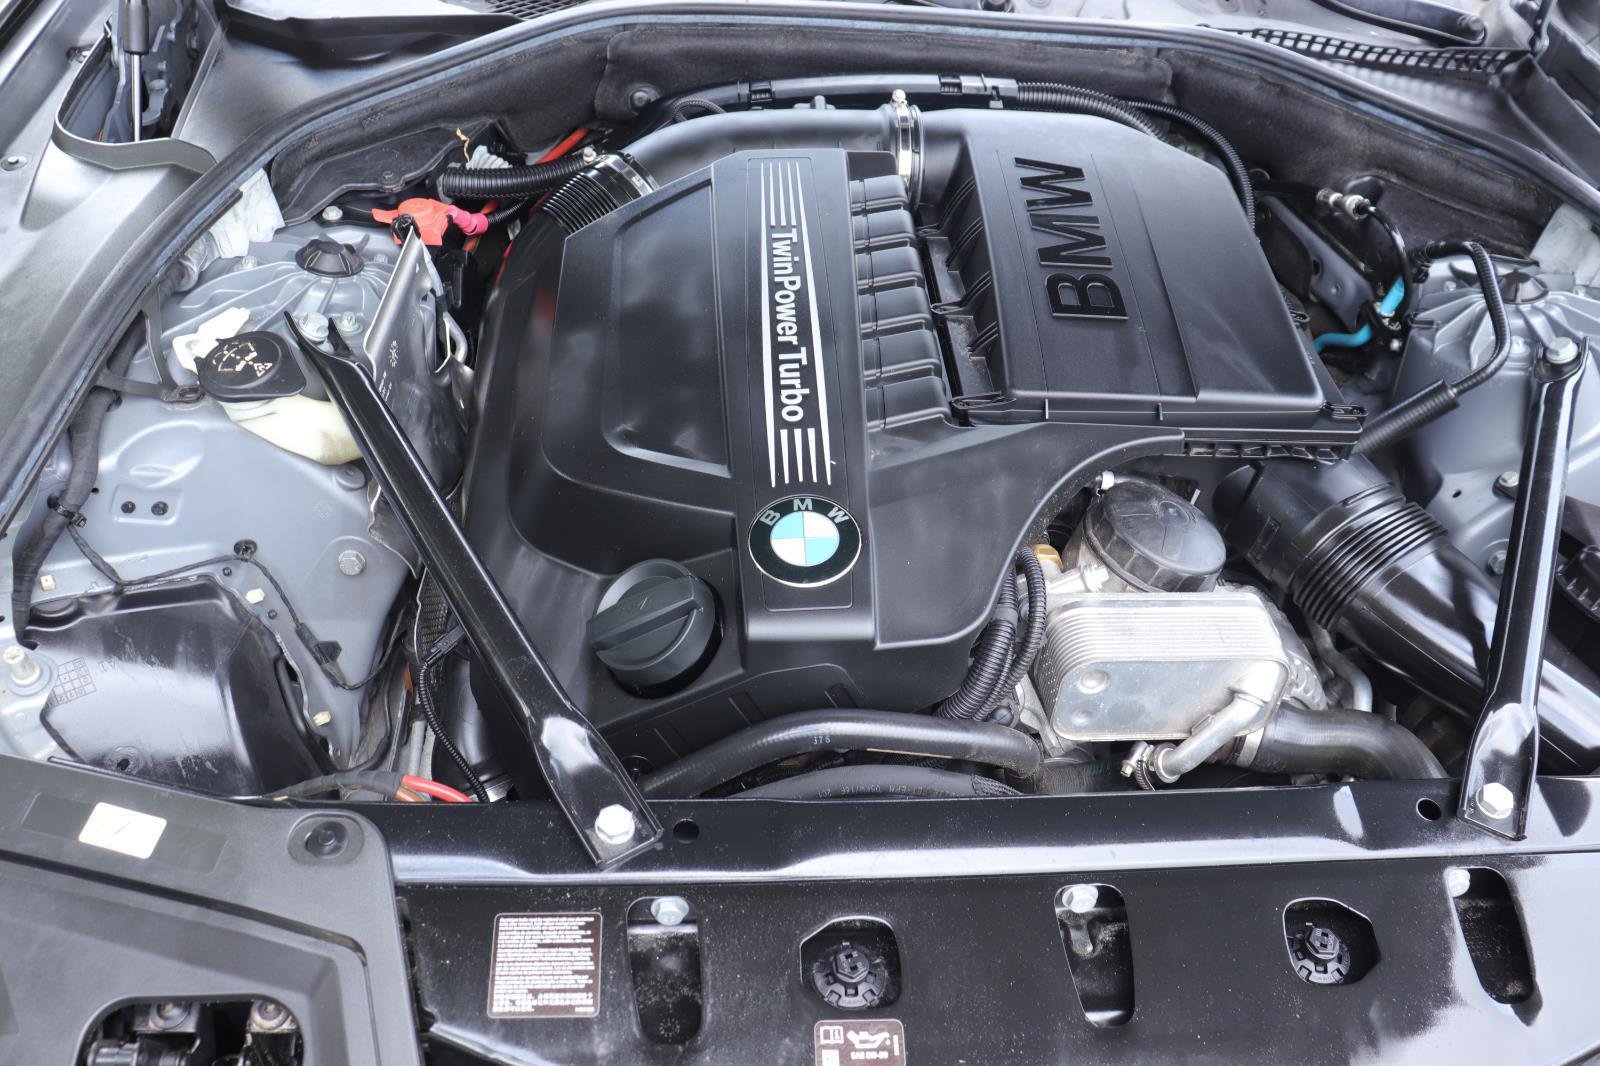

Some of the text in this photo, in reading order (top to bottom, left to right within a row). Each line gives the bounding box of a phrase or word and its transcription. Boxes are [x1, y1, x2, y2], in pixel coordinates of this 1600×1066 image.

[1014, 157, 1129, 320] BMW
[771, 228, 808, 422] TwinPower Turbo
[759, 498, 850, 527] BMW
